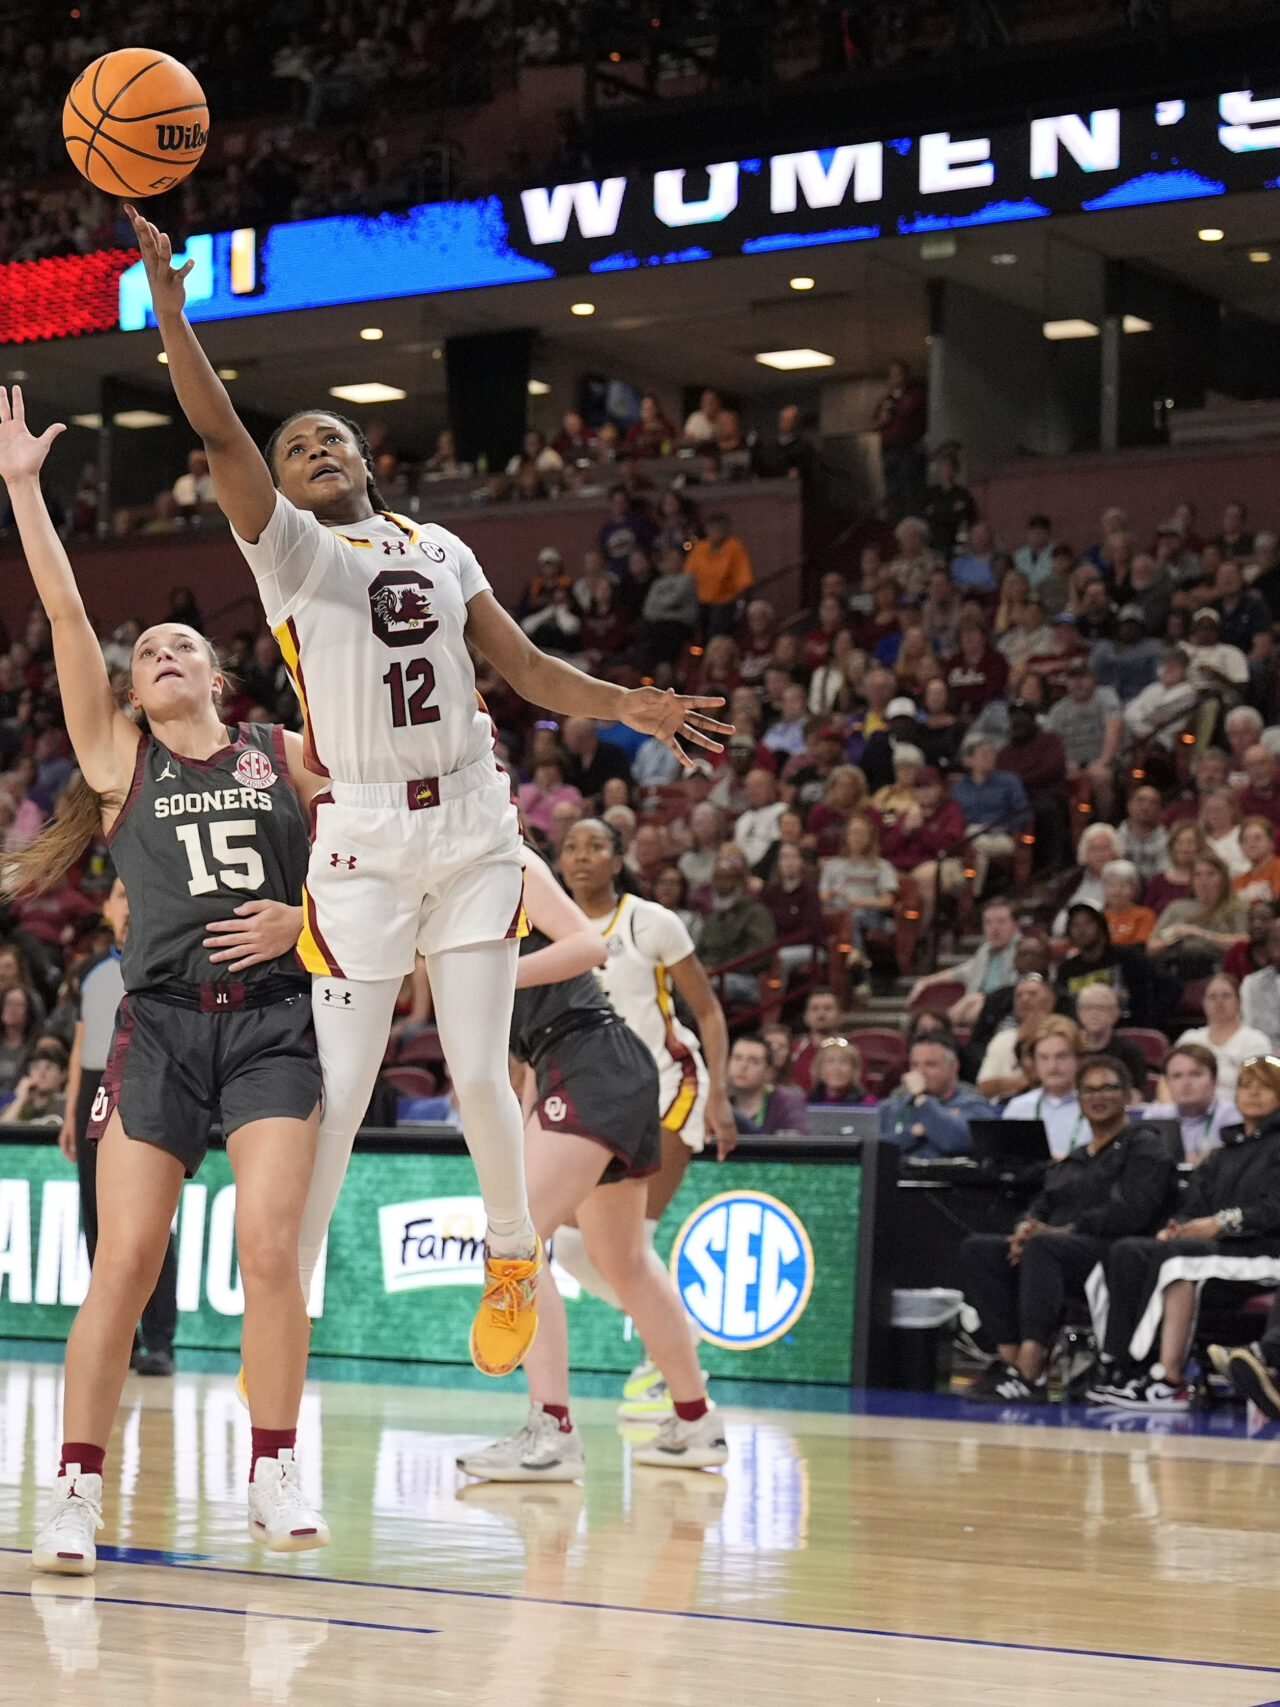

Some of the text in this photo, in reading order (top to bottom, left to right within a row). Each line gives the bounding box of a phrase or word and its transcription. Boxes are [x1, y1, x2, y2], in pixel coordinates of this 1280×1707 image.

[383, 657, 441, 728] 12
[239, 752, 269, 778] SEC
[154, 787, 273, 819] SOONERS
[175, 819, 266, 896] 15
[683, 1202, 801, 1337] SEC
